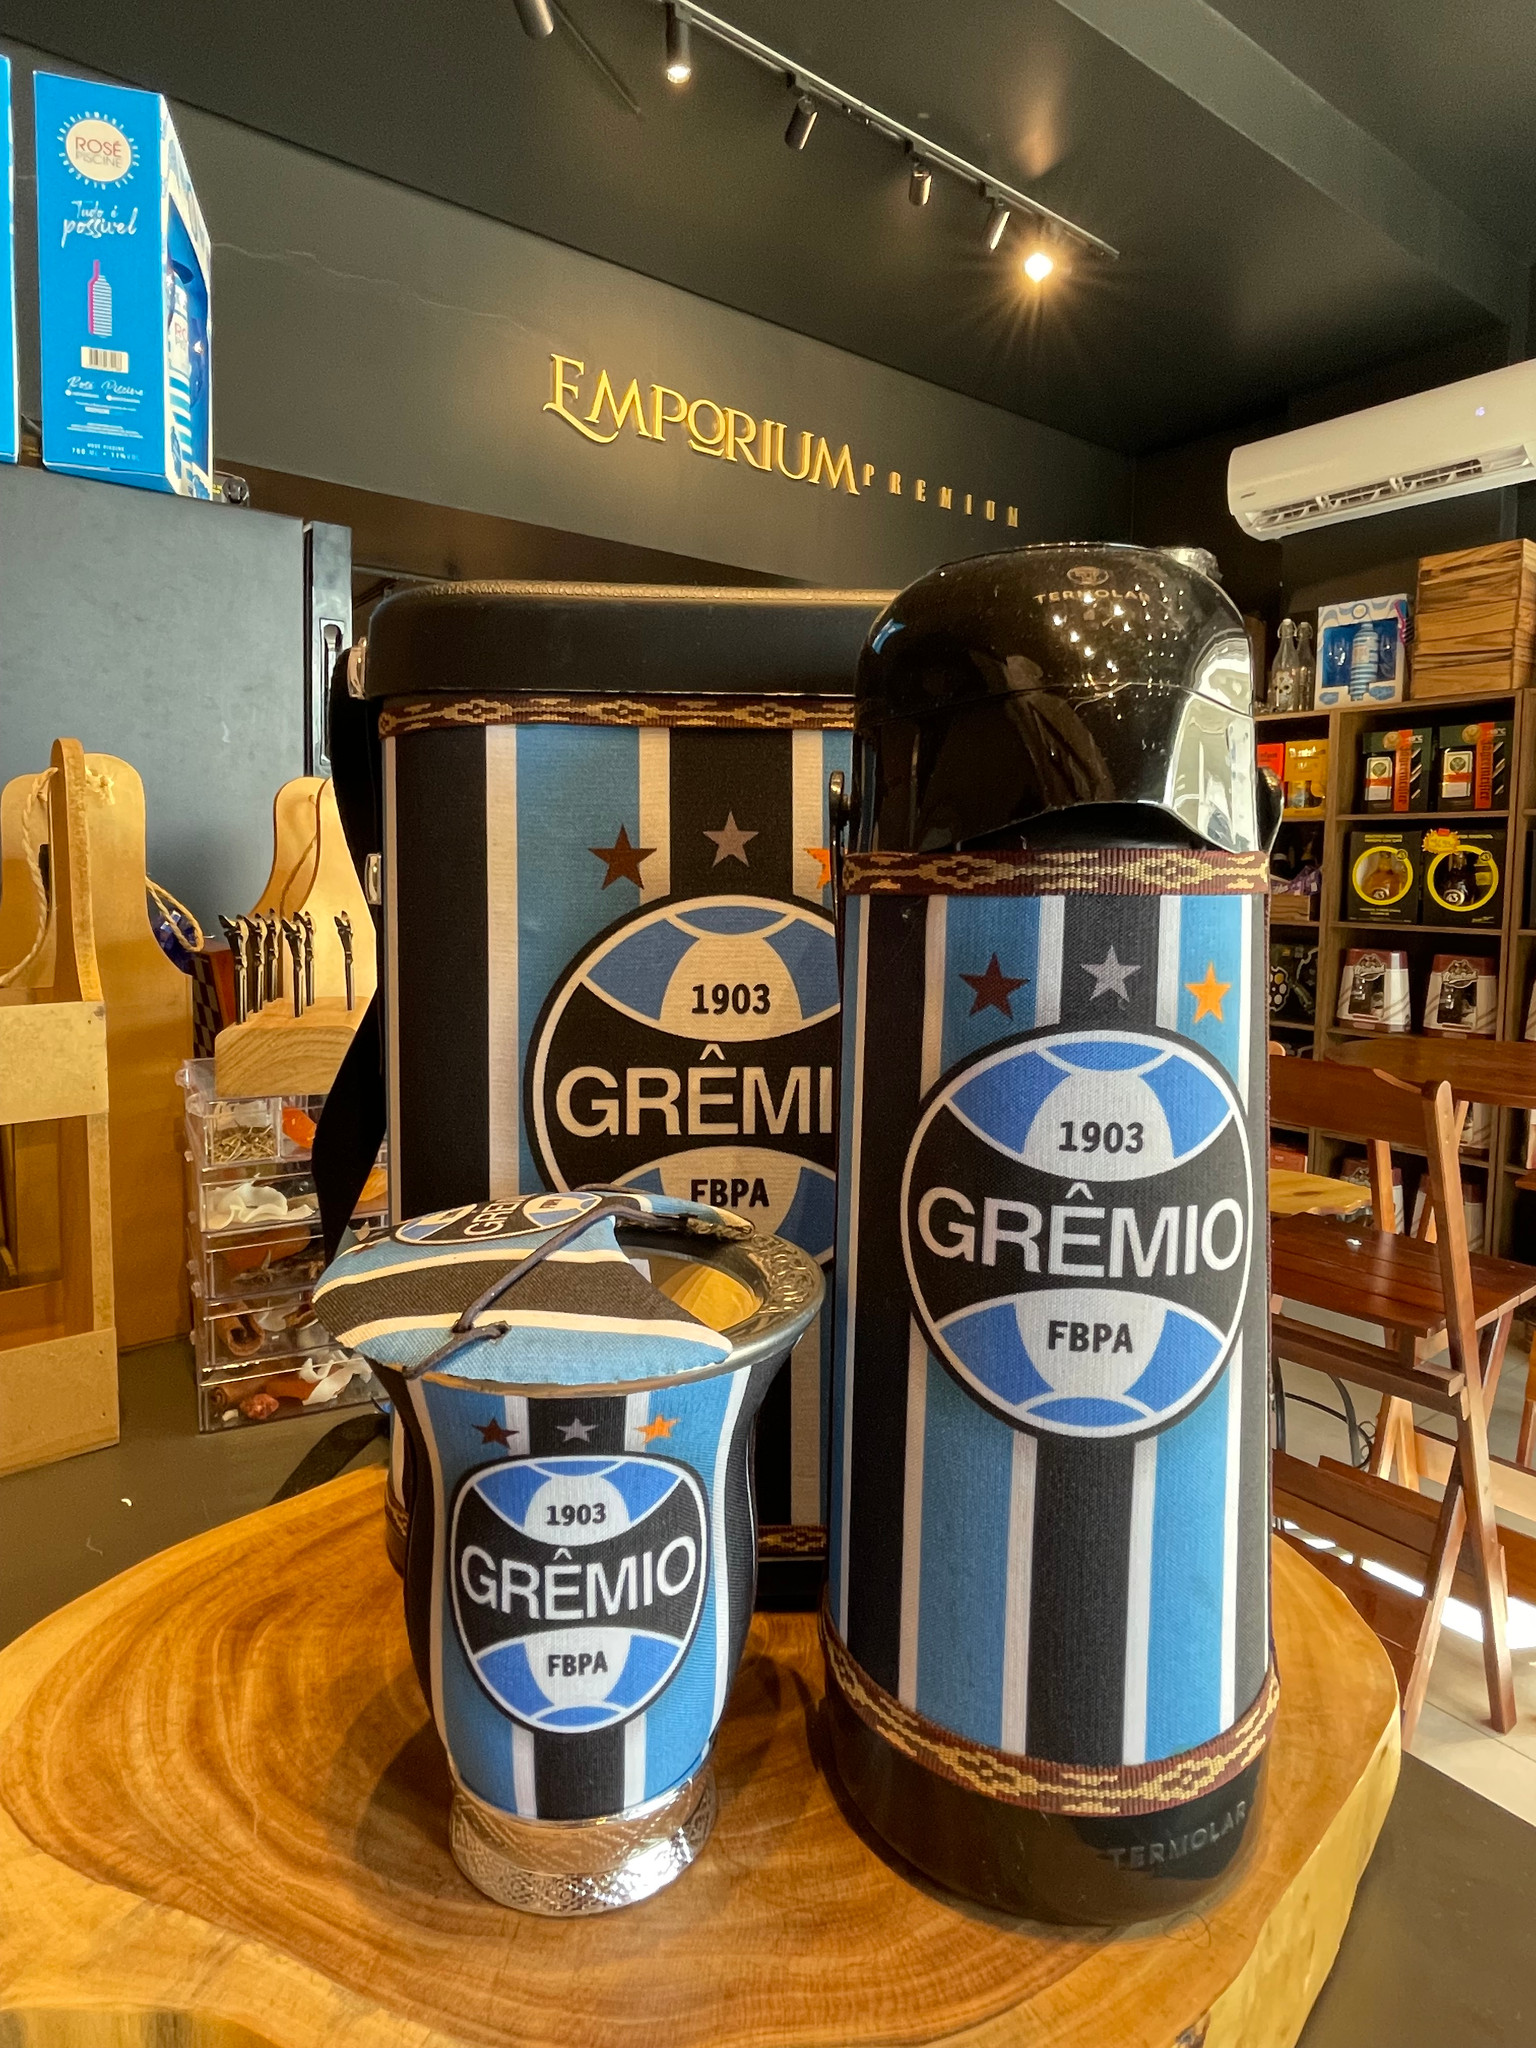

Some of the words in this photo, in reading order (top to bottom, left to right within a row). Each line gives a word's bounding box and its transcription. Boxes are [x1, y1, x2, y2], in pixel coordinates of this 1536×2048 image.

[75, 136, 122, 158] ROSÉ
[543, 353, 861, 496] EMPORIUM
[863, 463, 1020, 528] PREMIUM
[1446, 892, 1459, 904] 43
[691, 983, 771, 1015] 1903
[555, 1043, 833, 1138] GRÊMI
[1058, 1120, 1144, 1153] 1903
[690, 1178, 770, 1208] FBPA
[917, 1181, 1244, 1279] GRÊMIO
[1047, 1319, 1134, 1354] FBPA
[545, 1502, 608, 1527] 1903
[460, 1535, 697, 1621] GRÊMIO
[547, 1650, 609, 1678] FBPA
[1106, 1800, 1247, 1869] TERMOLAR
